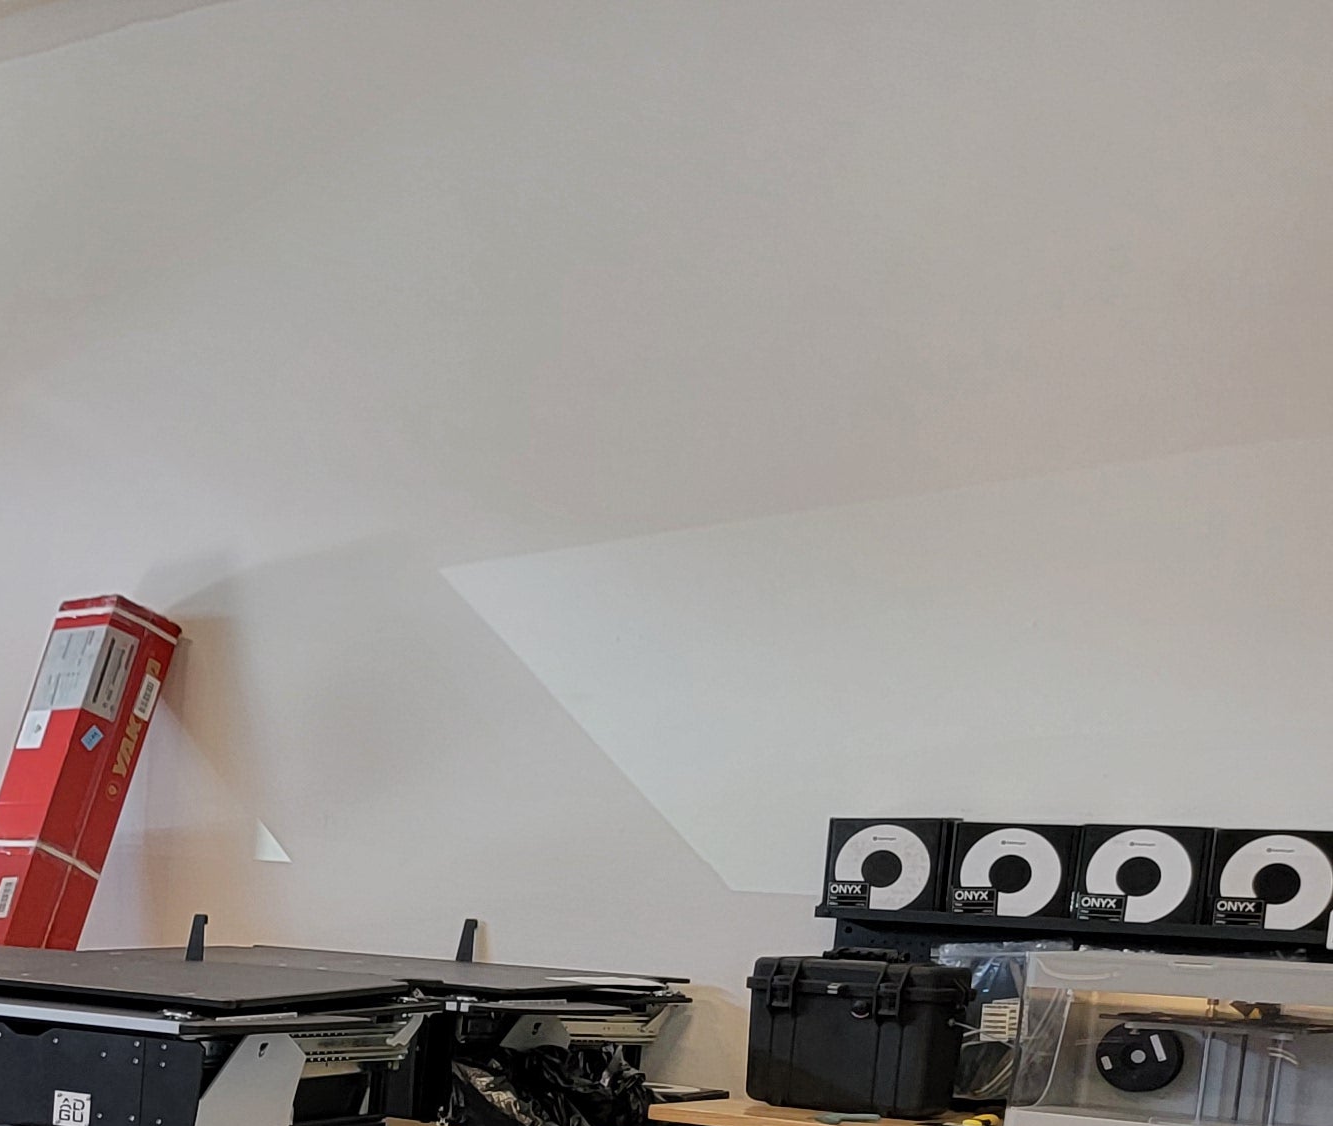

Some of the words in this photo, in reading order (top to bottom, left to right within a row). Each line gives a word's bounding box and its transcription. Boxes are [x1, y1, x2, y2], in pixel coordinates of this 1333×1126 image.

[830, 884, 862, 895] ONYX
[954, 890, 989, 901] ONYX
[1082, 896, 1117, 909] ONYX
[1216, 900, 1256, 913] ONYX
